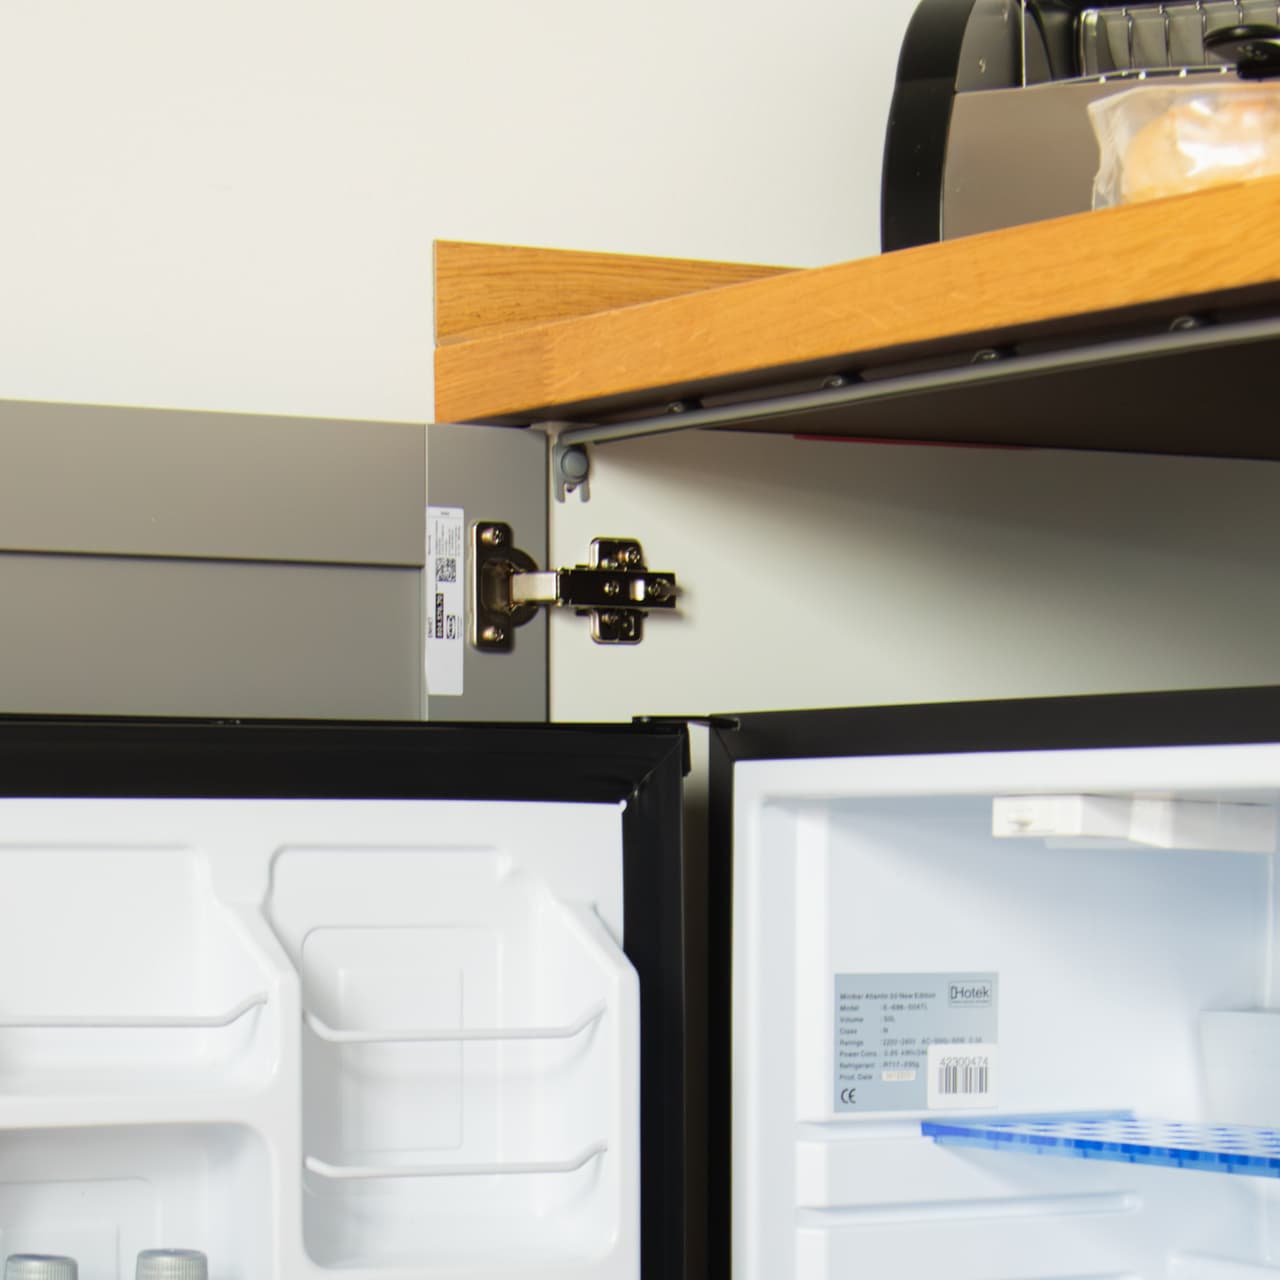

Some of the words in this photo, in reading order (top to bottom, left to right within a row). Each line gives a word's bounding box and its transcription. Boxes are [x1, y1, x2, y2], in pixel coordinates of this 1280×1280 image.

[955, 985, 990, 1000] Hotek
[839, 1016, 864, 1024] Volume
[839, 1050, 860, 1058] Power
[938, 1056, 989, 1067] 42300474
